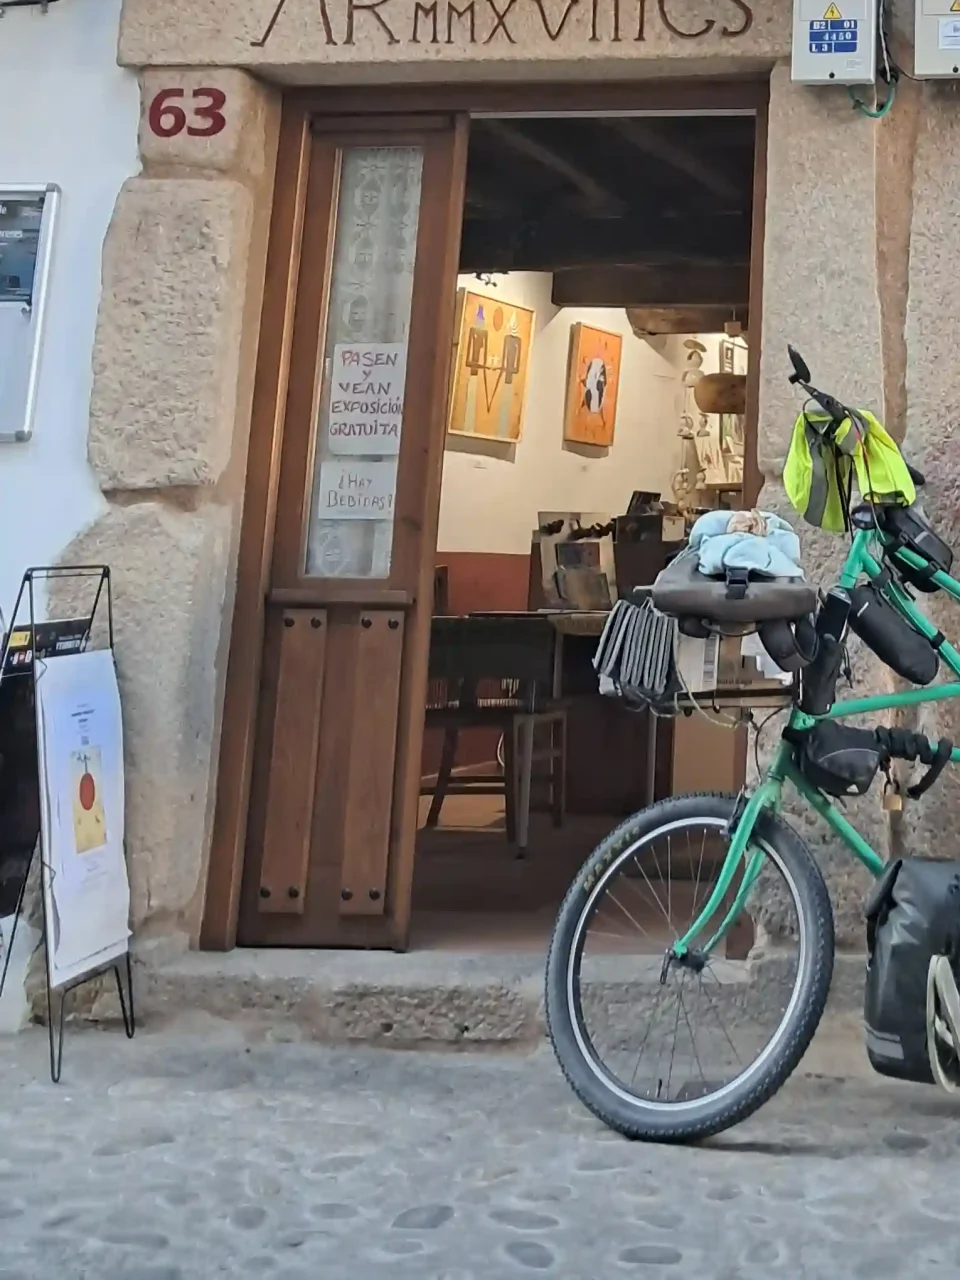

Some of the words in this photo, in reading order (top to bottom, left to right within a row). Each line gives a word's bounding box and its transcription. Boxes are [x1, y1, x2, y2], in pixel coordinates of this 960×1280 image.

[148, 87, 227, 138] 63
[341, 350, 398, 367] PASEN
[338, 381, 391, 395] VEAN
